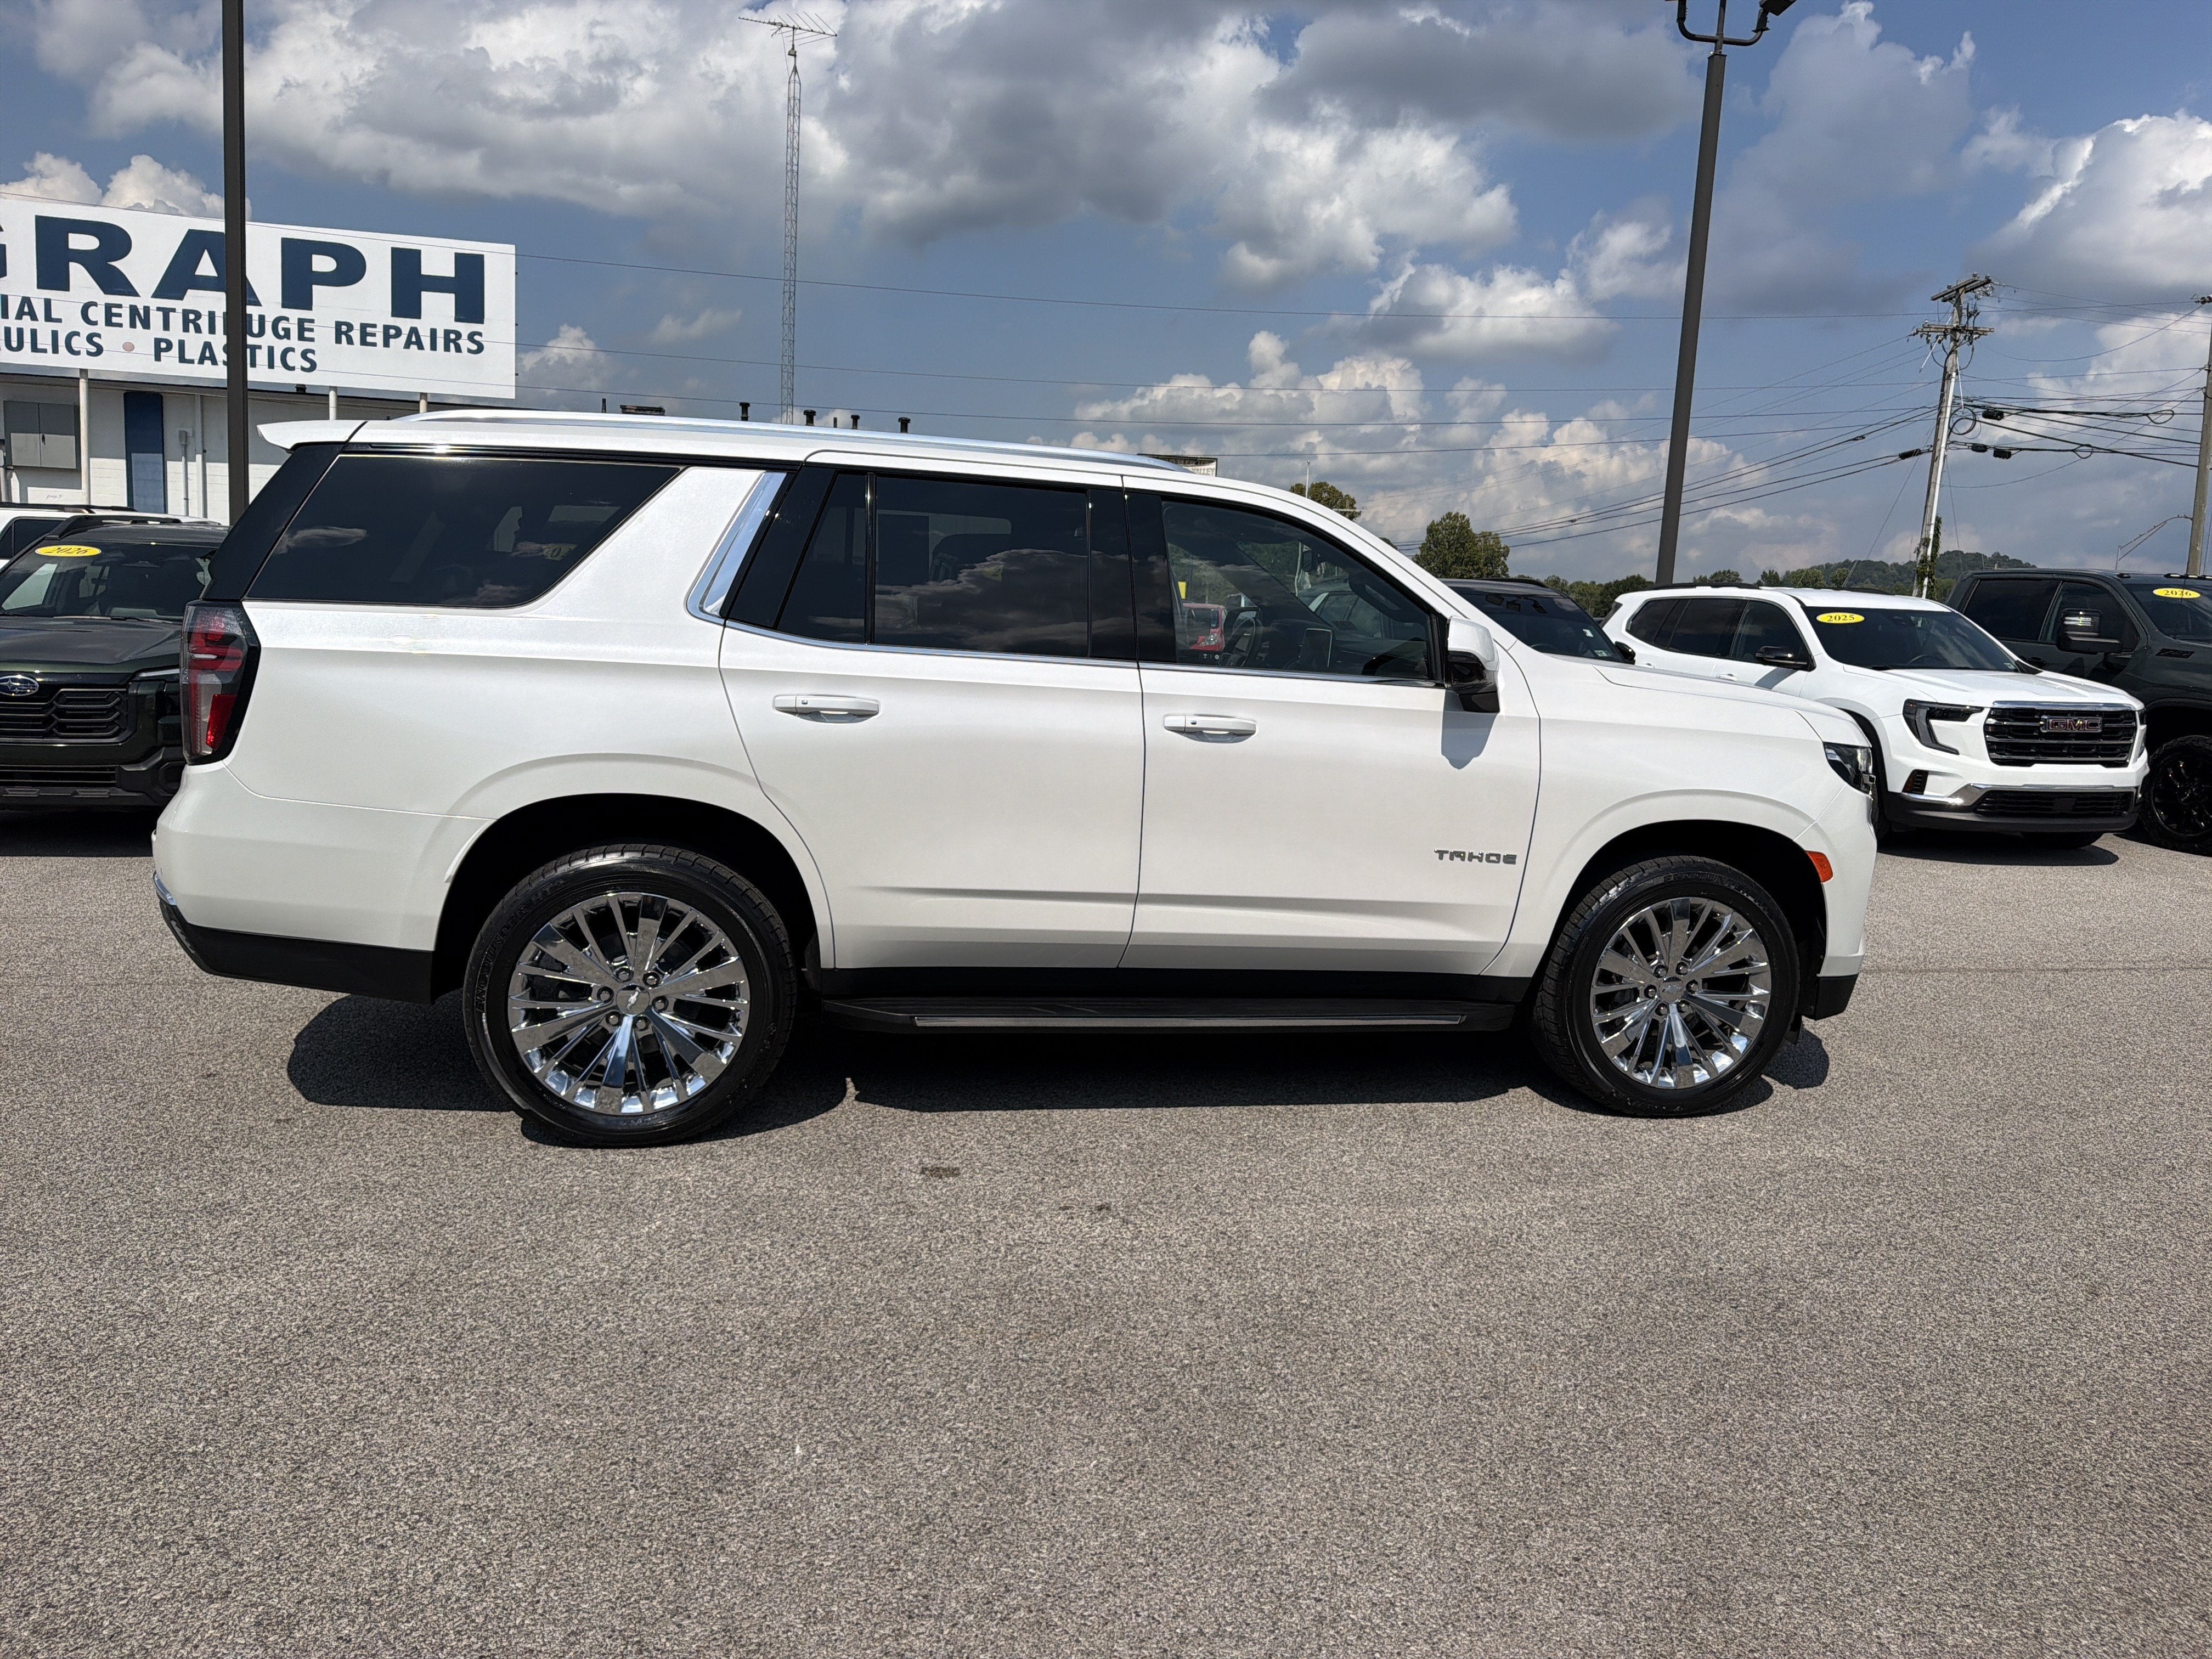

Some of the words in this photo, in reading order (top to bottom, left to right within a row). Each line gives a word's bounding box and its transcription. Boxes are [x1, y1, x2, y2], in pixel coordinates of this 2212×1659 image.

[0, 215, 484, 324] RAPH
[81, 301, 315, 342] CENTRIUGE
[335, 320, 484, 355] REPAIRS
[2049, 718, 2101, 731] GMC
[1434, 848, 1517, 865] TAHOE
